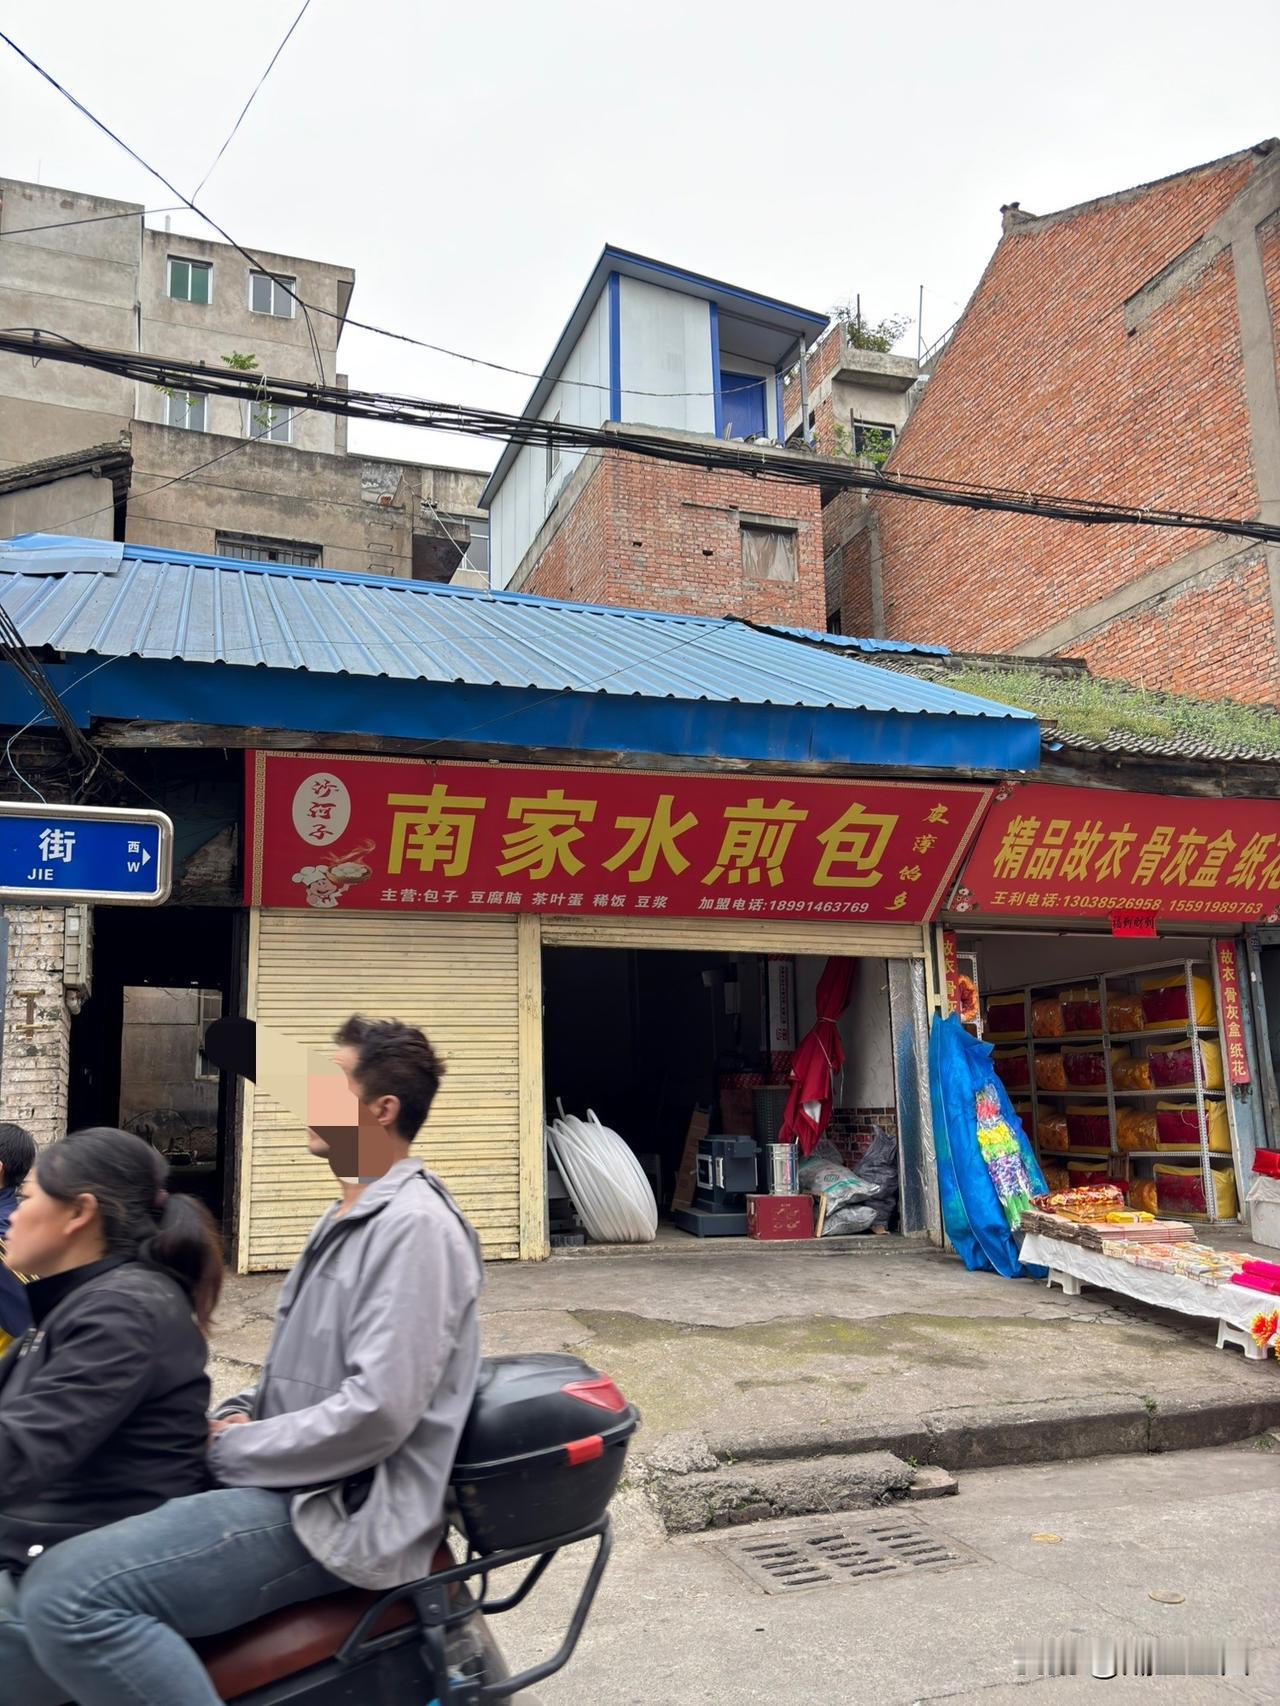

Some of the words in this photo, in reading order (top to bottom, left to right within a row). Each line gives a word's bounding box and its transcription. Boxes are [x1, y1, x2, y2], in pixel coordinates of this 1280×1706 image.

[387, 783, 899, 889] 南家水煎包
[38, 828, 76, 863] 街
[127, 840, 141, 853] 西
[27, 868, 54, 881] JIE
[127, 862, 140, 872] W
[532, 892, 584, 906] 茶叶蛋
[592, 893, 627, 908] 稀饭
[635, 895, 669, 909] 豆浆
[1169, 899, 1263, 914] 15591989763
